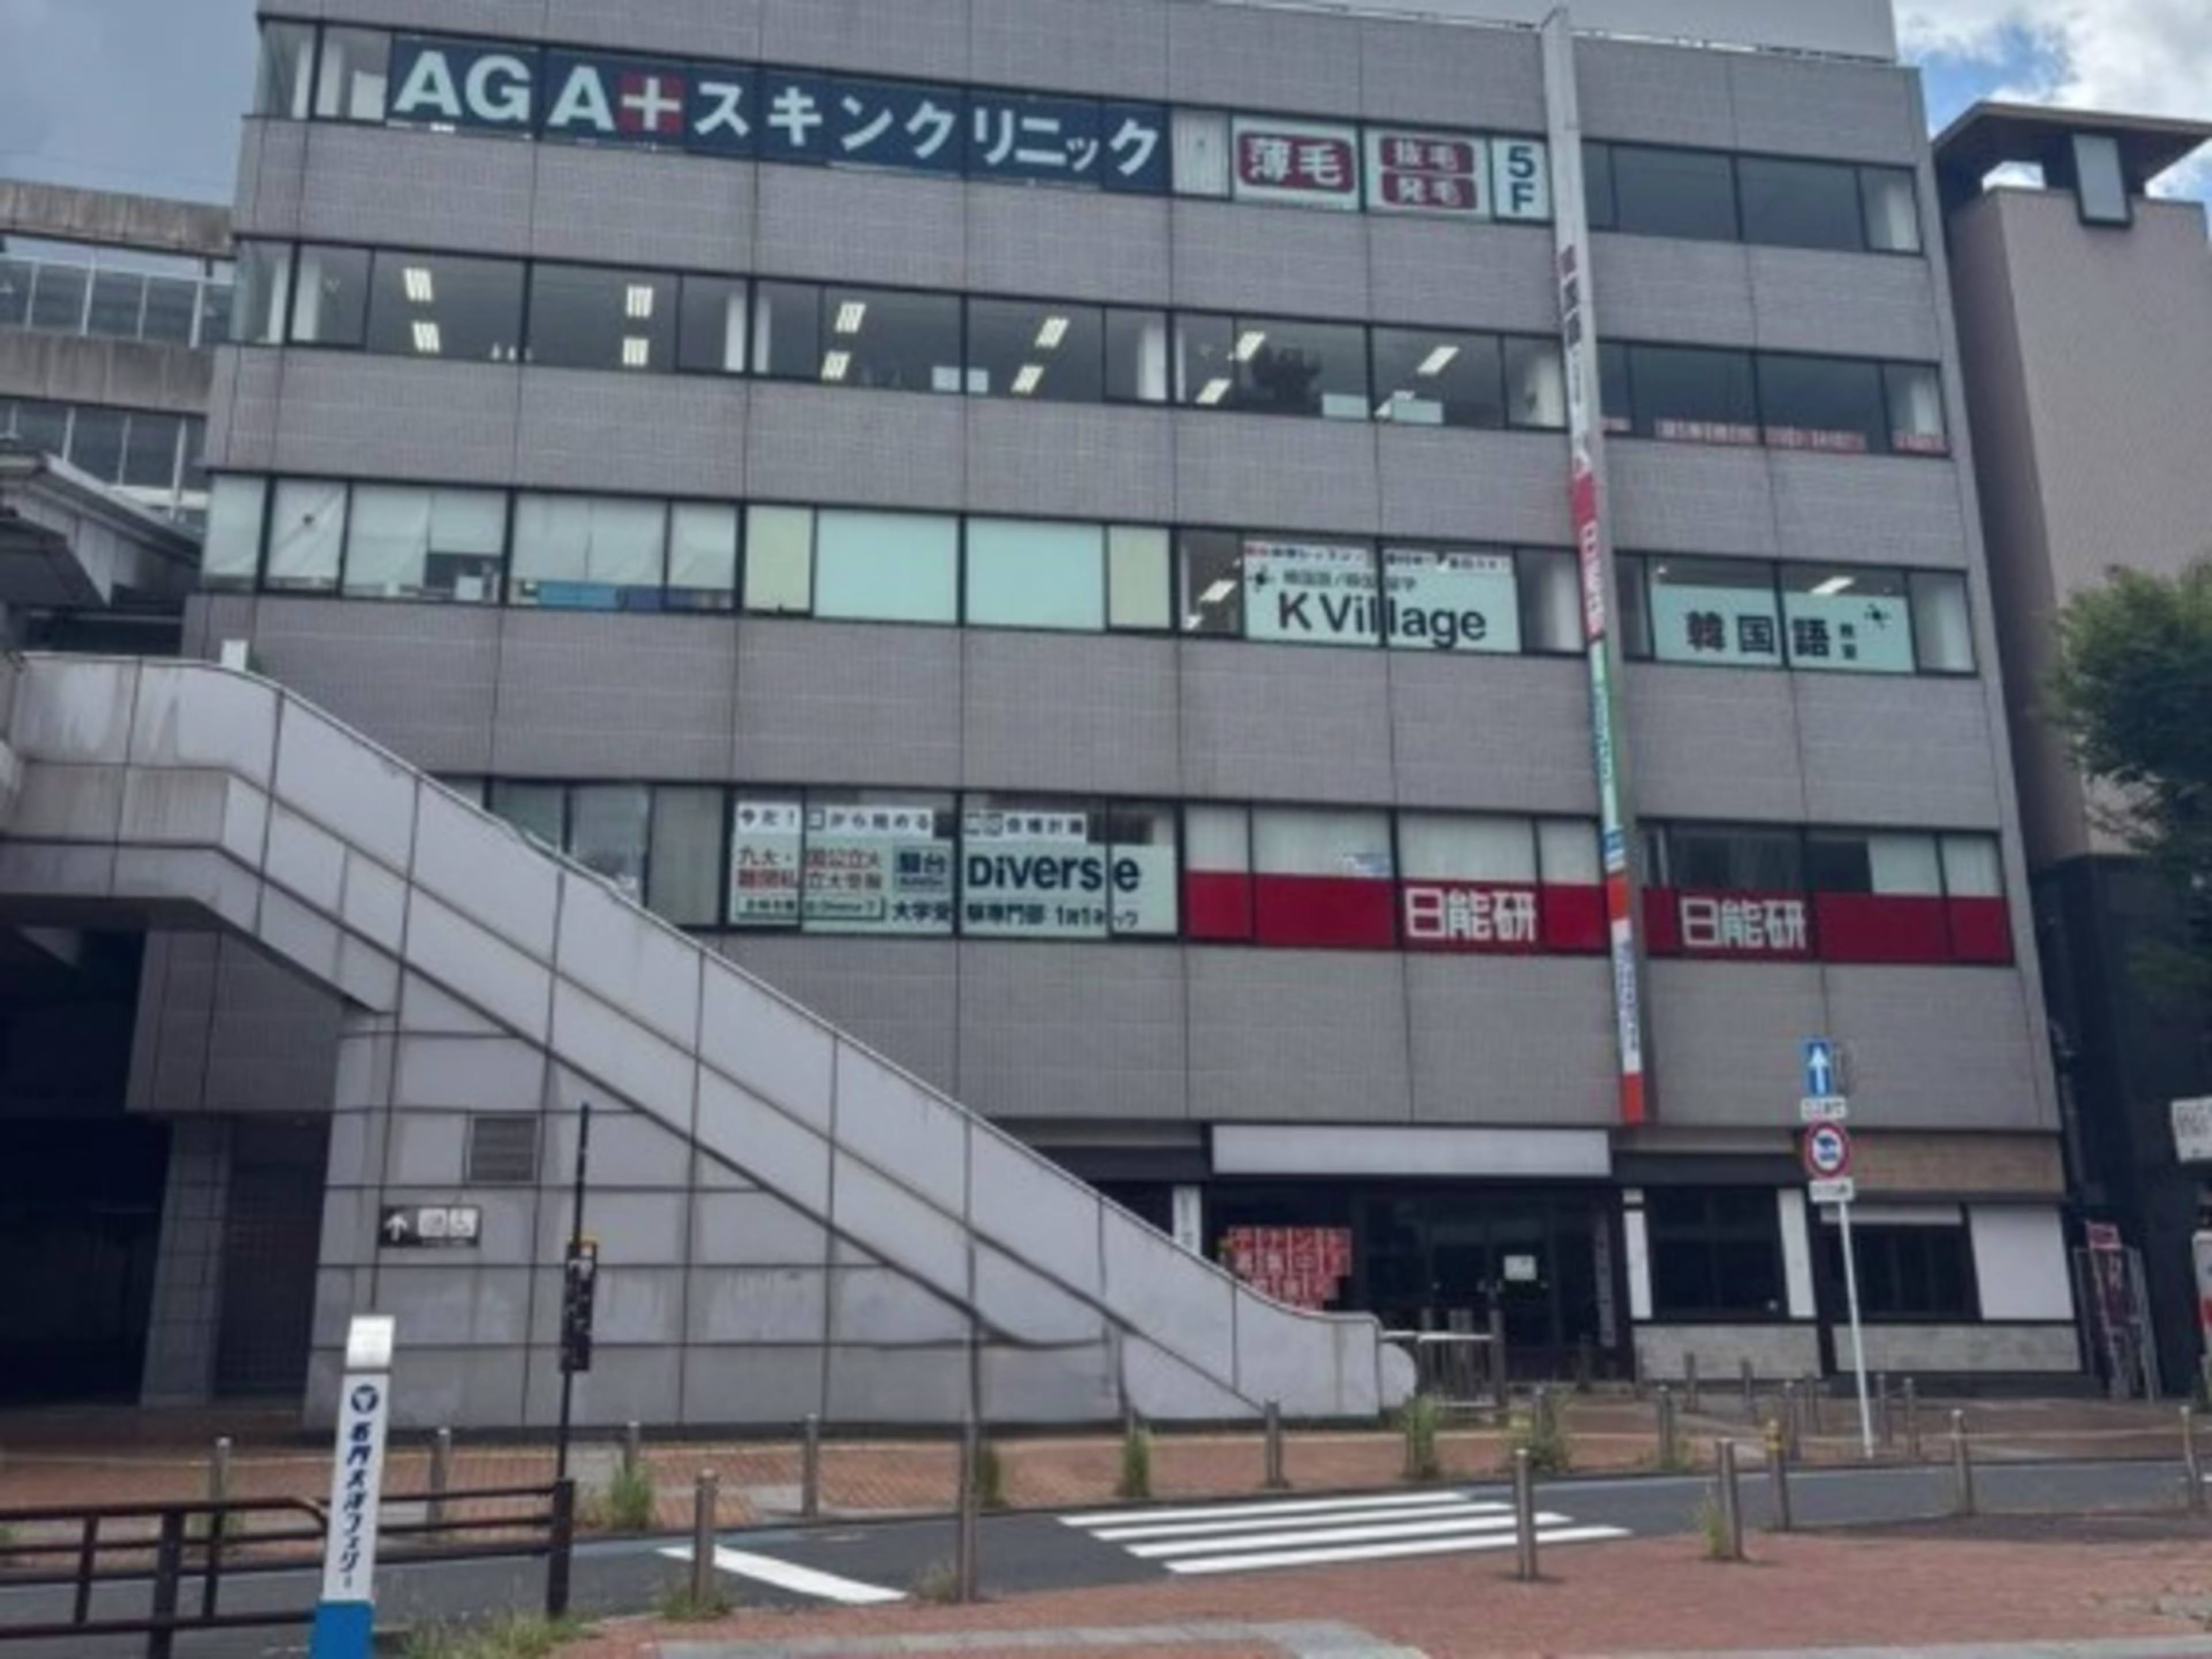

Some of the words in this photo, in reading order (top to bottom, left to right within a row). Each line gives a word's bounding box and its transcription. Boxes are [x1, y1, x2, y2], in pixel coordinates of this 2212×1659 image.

[1279, 593, 1312, 630] K
[1319, 594, 1486, 647] Village
[968, 854, 1141, 892] Diverse
[1404, 887, 1537, 942] 日能研
[1680, 896, 1806, 949] 日能研
